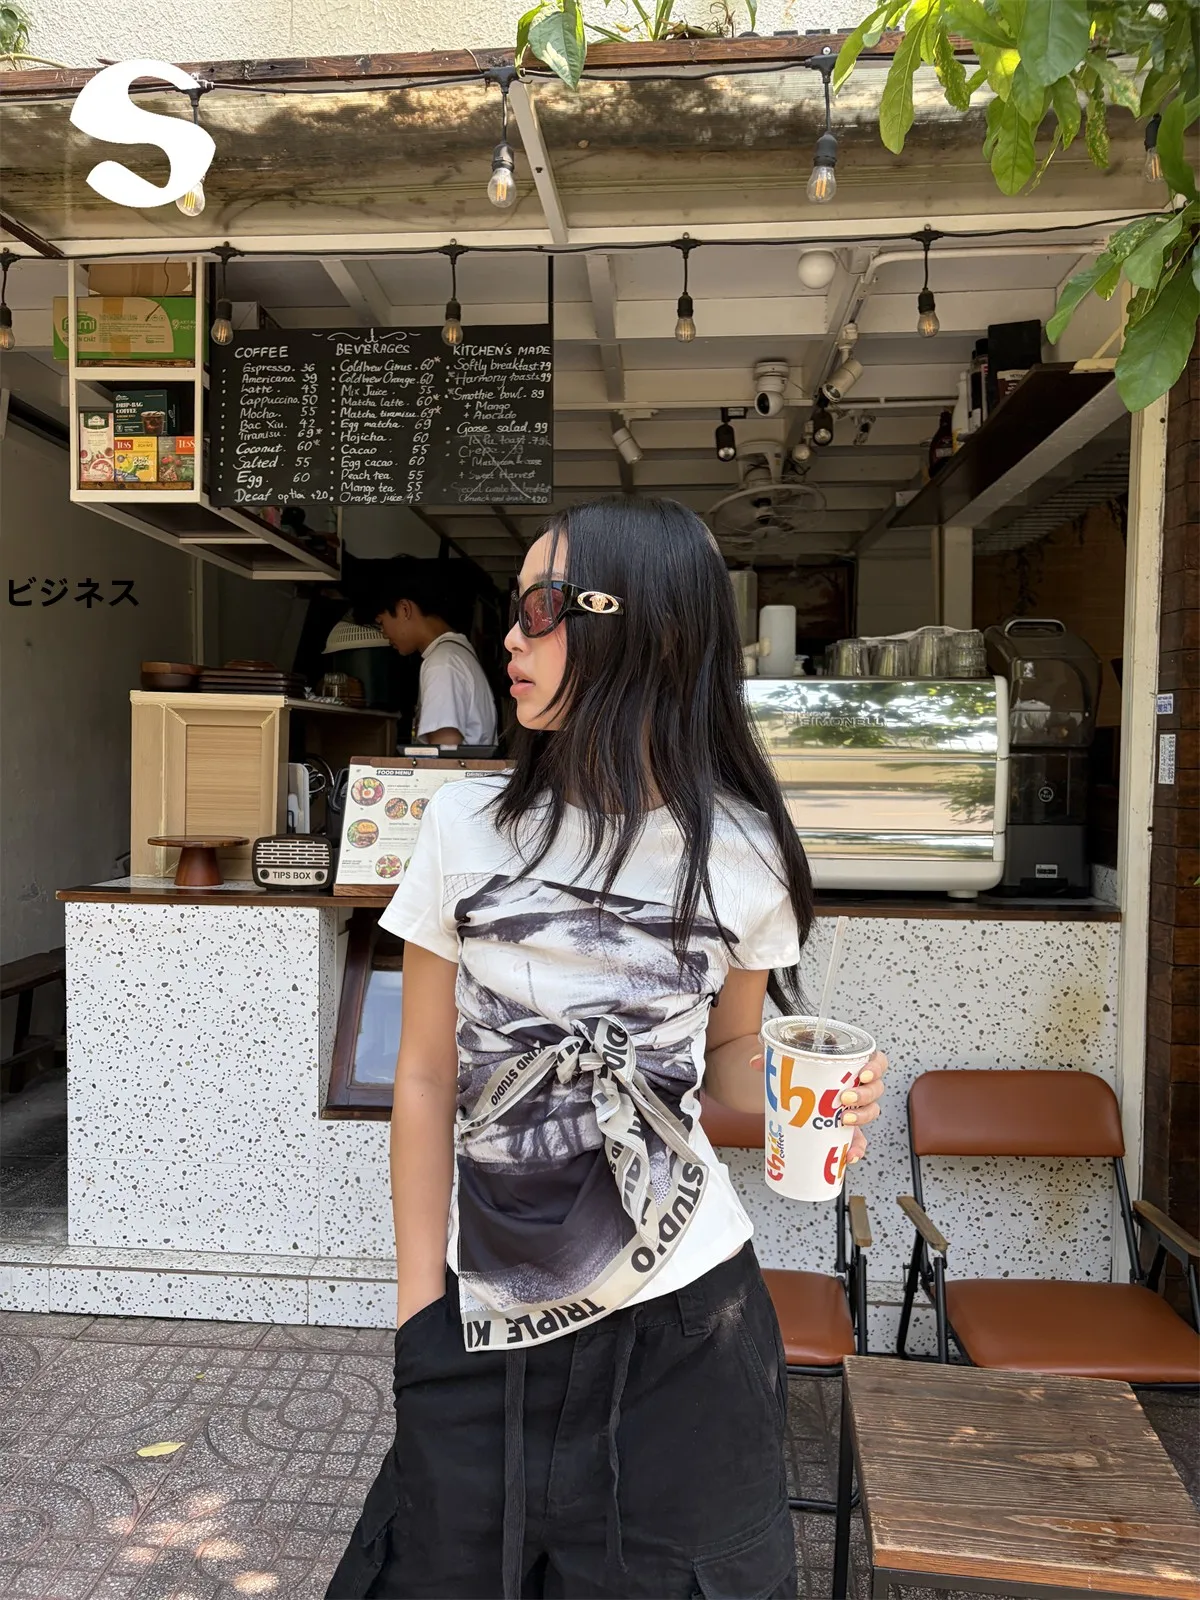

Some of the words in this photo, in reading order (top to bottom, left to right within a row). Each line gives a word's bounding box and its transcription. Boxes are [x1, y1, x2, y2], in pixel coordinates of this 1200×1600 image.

[235, 346, 288, 358] COFFEE
[518, 346, 552, 355] MADE
[300, 363, 315, 372] 36
[420, 358, 434, 370] 60
[454, 358, 487, 377] Softly
[540, 361, 552, 371] 79
[302, 373, 318, 383] 39
[420, 373, 434, 384] 60
[455, 371, 507, 389] Harmony
[540, 373, 552, 382] 99
[301, 384, 319, 394] 45
[341, 385, 360, 396] Mix
[363, 385, 387, 396] Juice
[419, 386, 435, 395] 55
[531, 389, 545, 399] 89
[302, 395, 318, 405] 50
[341, 397, 377, 407] Matcha
[416, 396, 433, 406] 60
[300, 406, 318, 416] 55
[340, 407, 377, 418] Matcha
[420, 408, 434, 419] 69
[475, 401, 511, 414] Mango
[473, 410, 517, 420] Avocado
[299, 418, 315, 429] 42
[340, 419, 359, 432] Egg
[415, 419, 432, 430] 69
[534, 422, 548, 434] 99
[297, 428, 314, 438] 69
[412, 432, 429, 443] 60
[297, 441, 312, 451] 60
[341, 444, 377, 455] Cacao
[412, 444, 430, 455] 55
[233, 455, 279, 470] Salted
[295, 457, 312, 467] 55
[341, 456, 361, 471] Egg
[408, 456, 425, 466] 60
[293, 472, 310, 482] 60
[341, 468, 371, 480] Peach
[408, 470, 425, 480] 55
[341, 481, 375, 496] Mango
[378, 482, 395, 492] tea
[406, 481, 423, 492] 55
[234, 488, 273, 503] Decaf
[278, 488, 306, 504] option
[340, 491, 377, 504] Orange
[380, 493, 404, 503] juice
[407, 492, 423, 504] 45
[272, 871, 291, 880] TIPS
[293, 871, 311, 880] BOX
[491, 1068, 519, 1106] STUDIO
[631, 1162, 704, 1273] STUDO
[505, 1298, 606, 1344] TRIPLE
